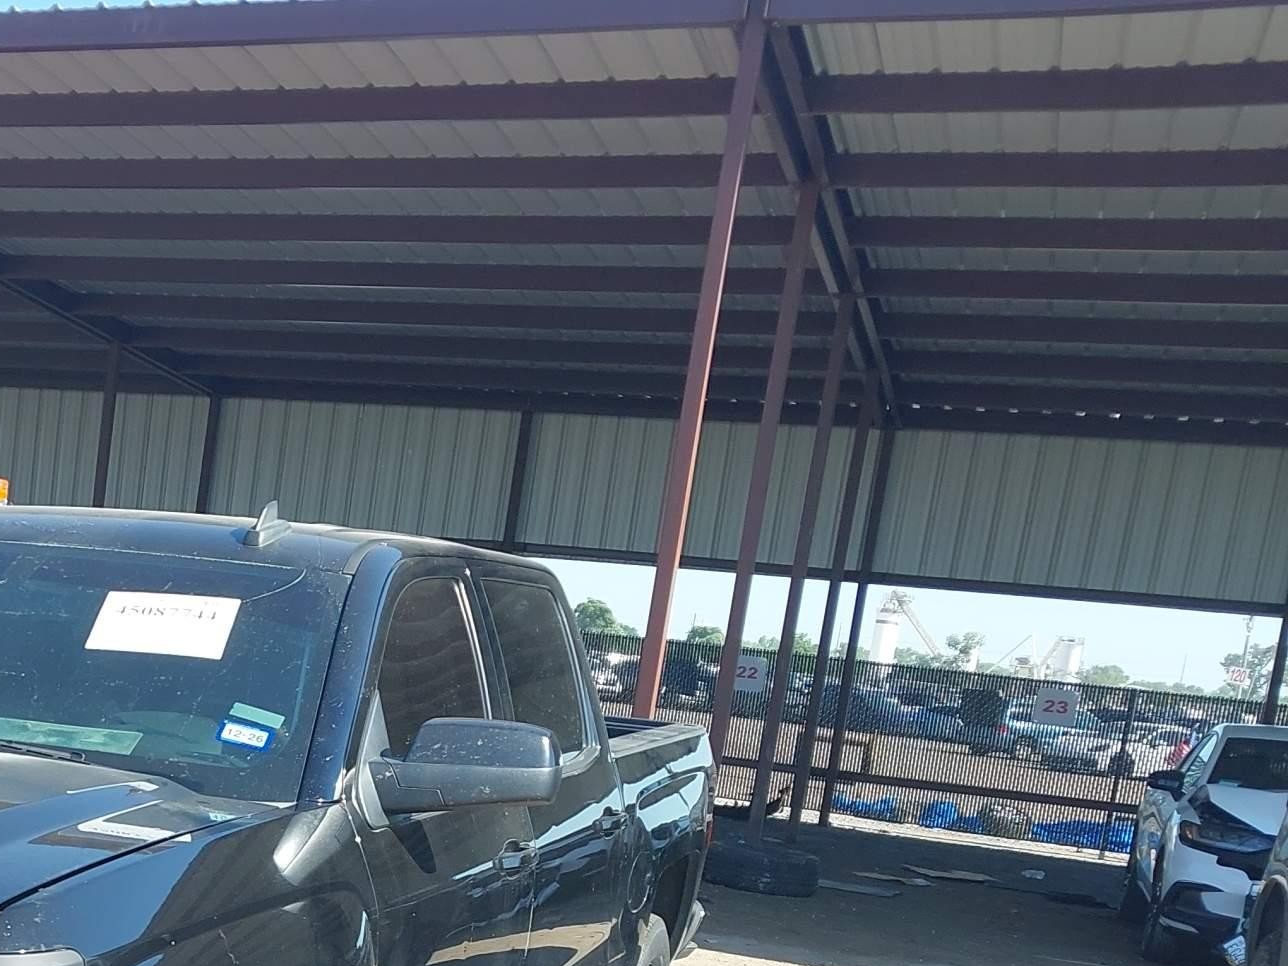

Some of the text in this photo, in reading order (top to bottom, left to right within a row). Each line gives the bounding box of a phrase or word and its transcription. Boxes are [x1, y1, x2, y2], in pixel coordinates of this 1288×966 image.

[115, 605, 217, 621] 45087744
[735, 665, 759, 680] 22
[1042, 699, 1069, 714] 23
[227, 727, 264, 744] 12-26
